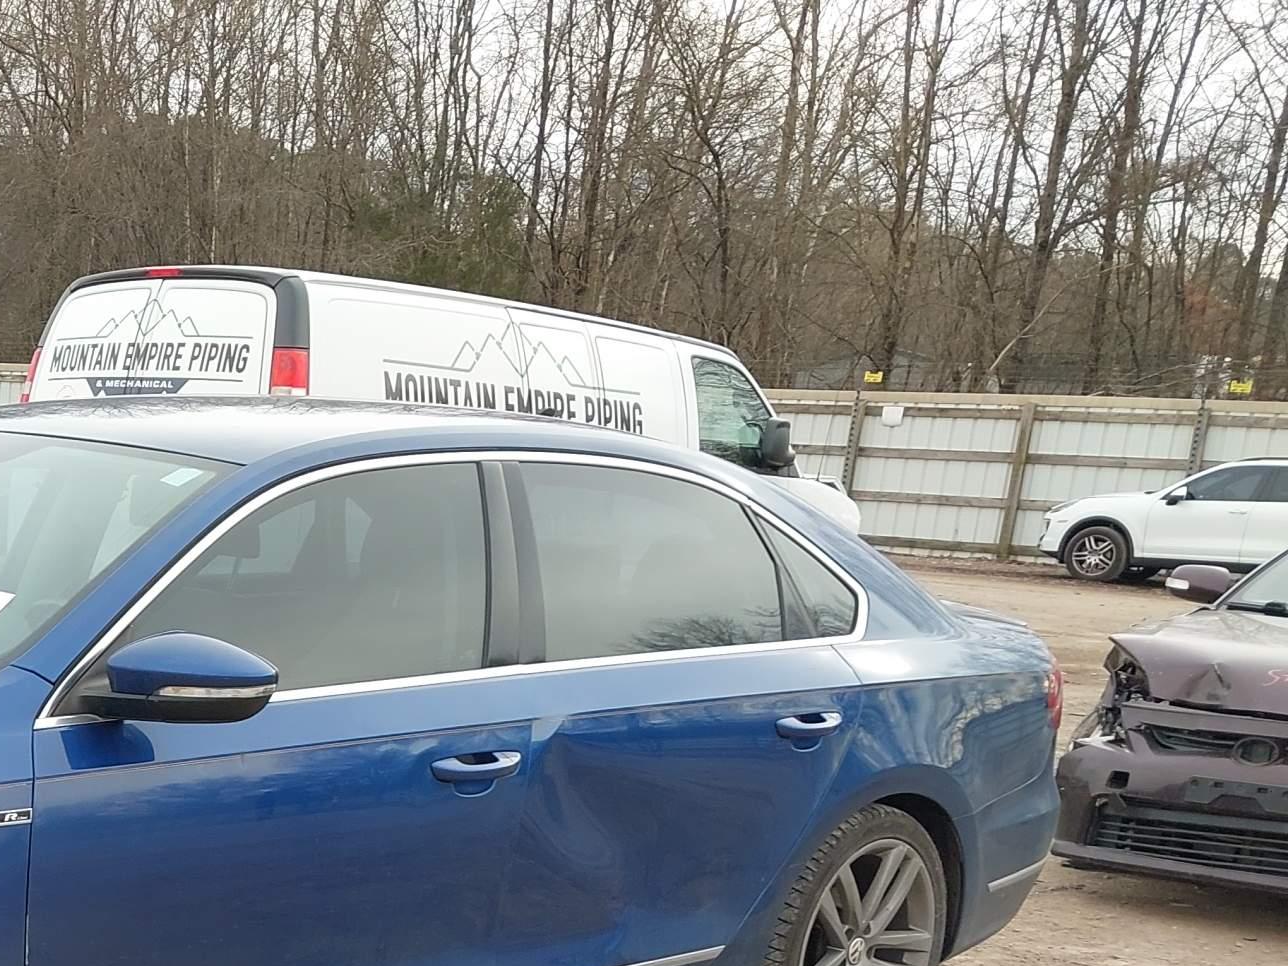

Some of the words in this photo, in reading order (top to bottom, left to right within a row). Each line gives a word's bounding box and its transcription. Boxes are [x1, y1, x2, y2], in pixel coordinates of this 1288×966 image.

[50, 342, 122, 373] MOUNTAIN
[122, 342, 186, 372] EMPIRE
[188, 343, 251, 374] PIPING
[95, 380, 103, 388] &
[105, 380, 174, 388] MECHANICAL
[384, 371, 497, 410] MOUNTAIN
[584, 396, 643, 435] PIPING
